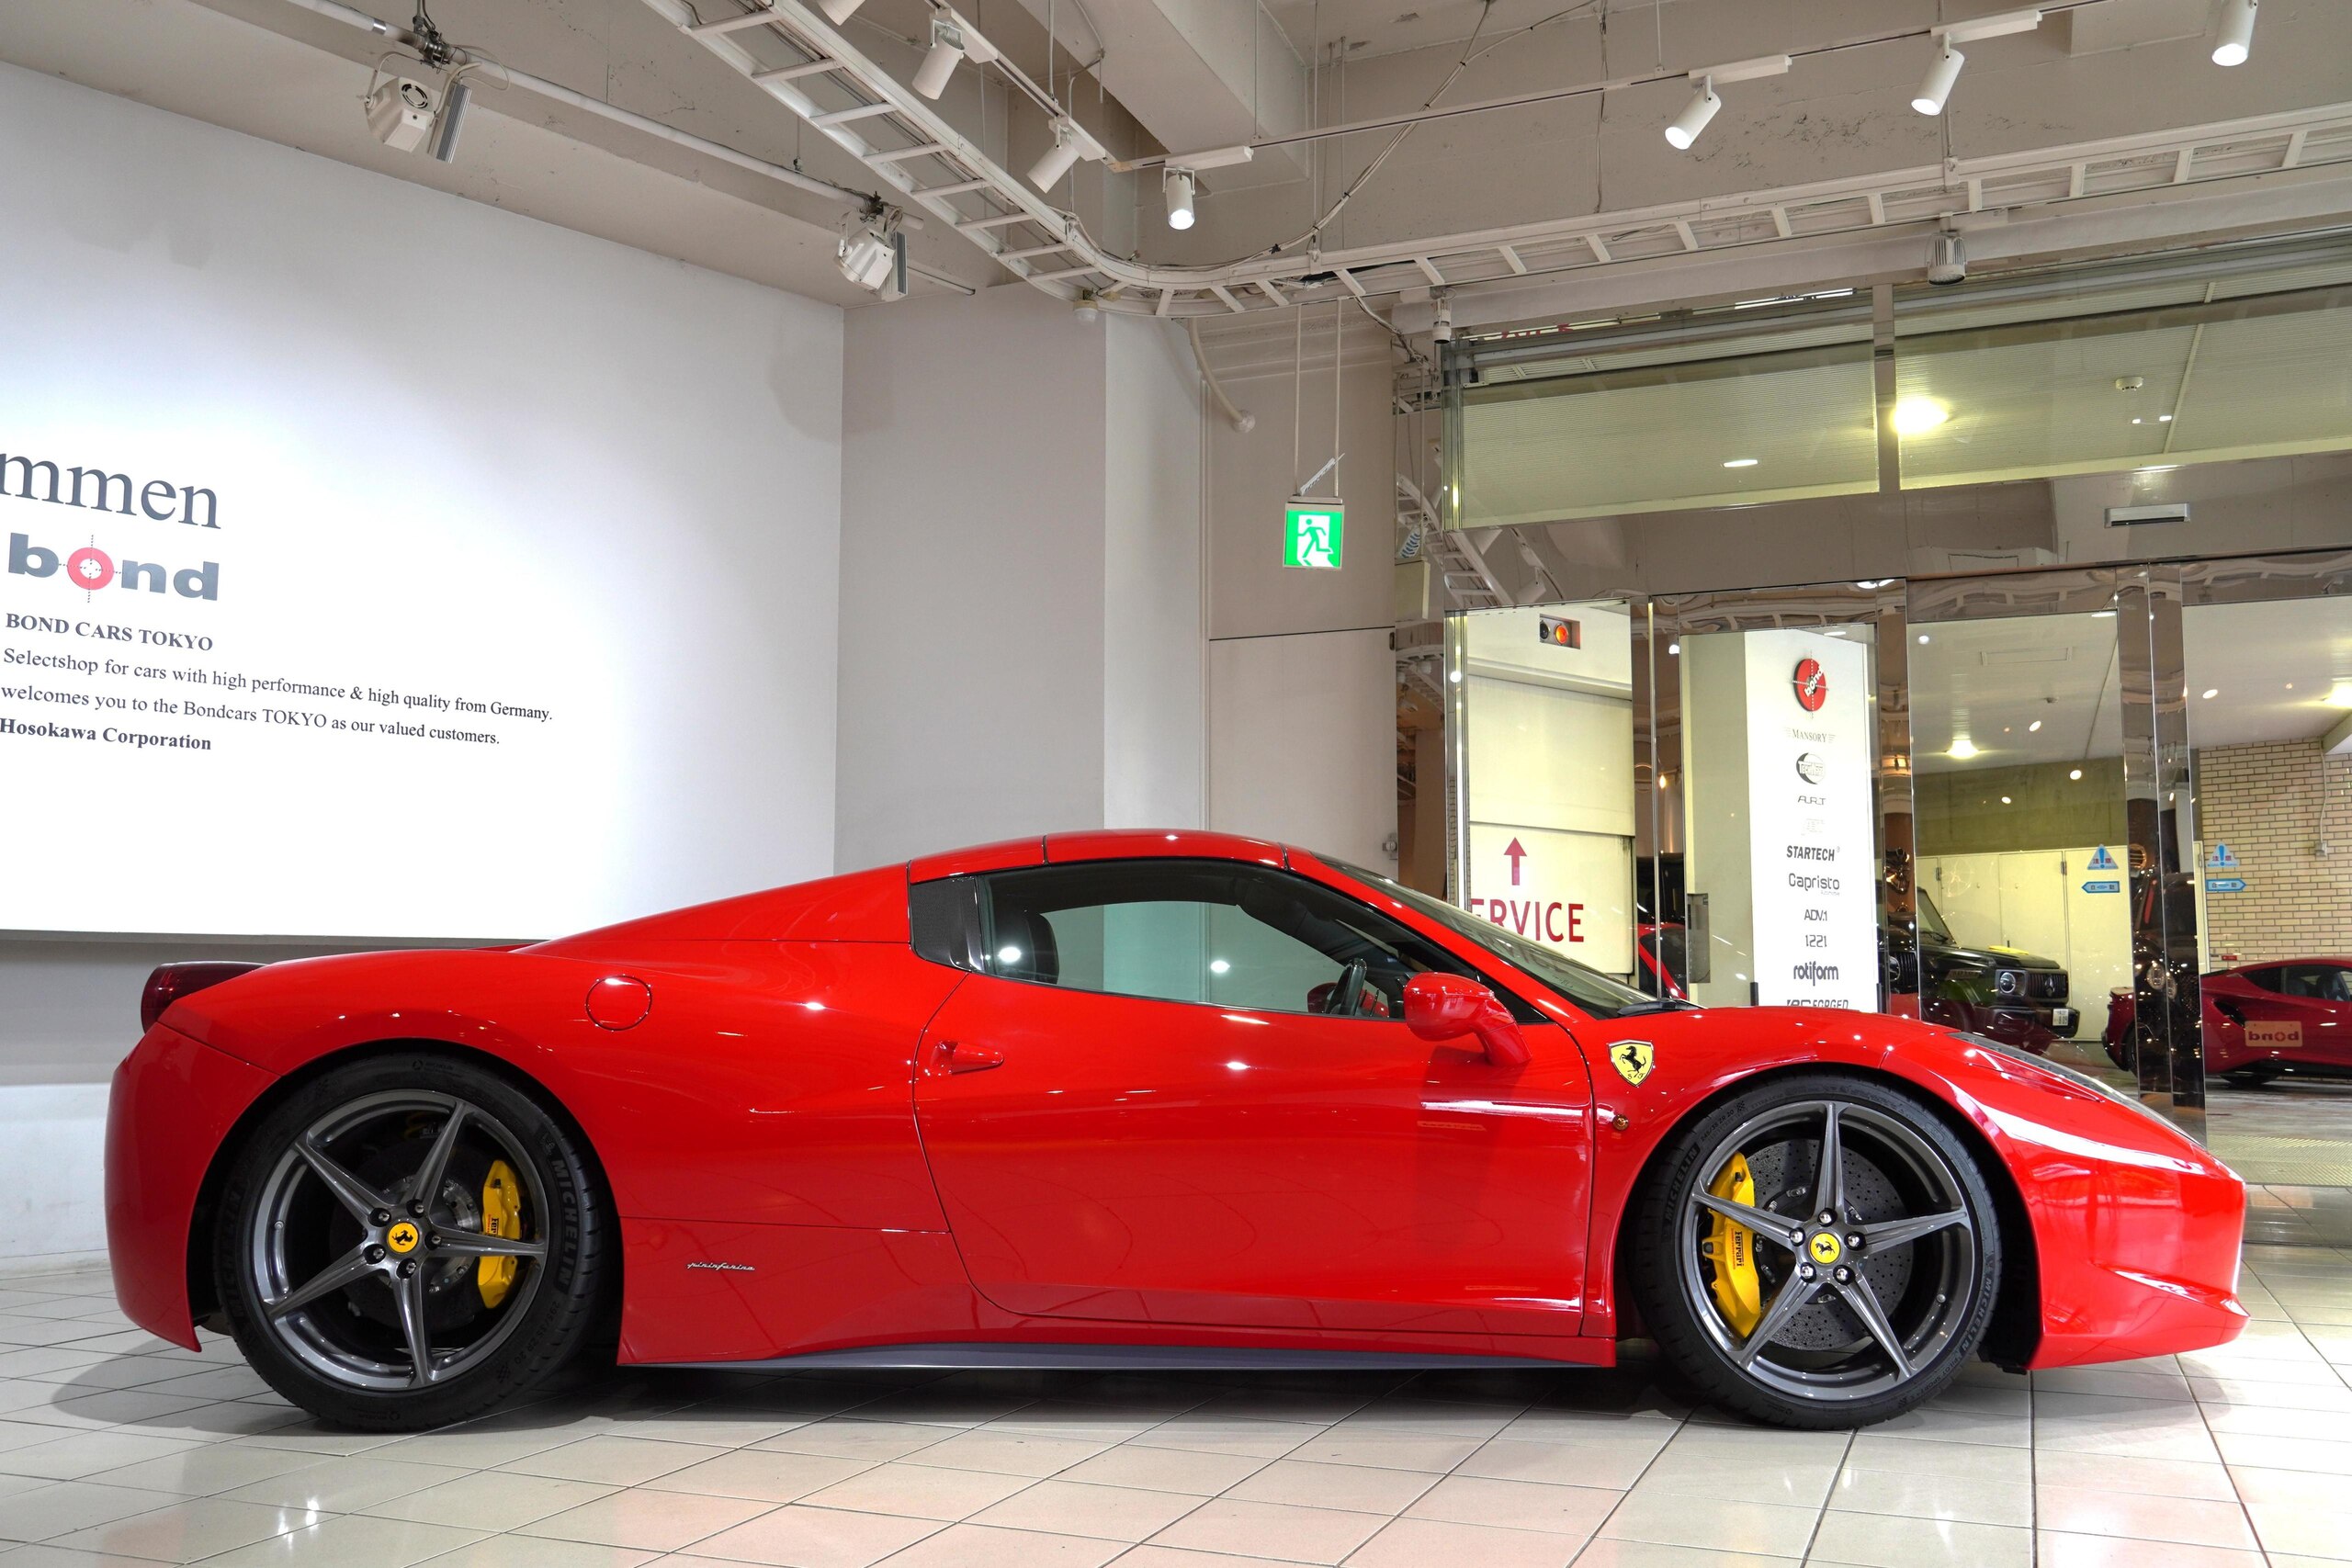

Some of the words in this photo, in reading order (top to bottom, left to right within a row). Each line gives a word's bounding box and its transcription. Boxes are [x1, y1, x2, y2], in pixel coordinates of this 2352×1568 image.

[0, 454, 221, 529] mmen
[8, 532, 220, 602] bond
[6, 614, 69, 633] BOND
[75, 622, 132, 641] CARS
[139, 629, 212, 650] TOKYO
[4, 649, 97, 675] Selectshop
[106, 660, 129, 674] for
[134, 667, 166, 679] cars
[173, 670, 207, 683] with
[213, 671, 246, 690] high
[252, 678, 345, 697] performance
[350, 686, 362, 700] &
[368, 688, 399, 705] high
[404, 694, 450, 712] quality
[456, 697, 486, 713] from
[491, 702, 551, 722] Germany.
[1804, 665, 1824, 697] bond
[1, 686, 89, 705] welcomes
[96, 696, 126, 710] you
[132, 699, 147, 710] to
[153, 699, 177, 714] the
[185, 701, 256, 721] Bondcars
[263, 709, 326, 728] TOKYO
[332, 719, 346, 729] as
[351, 721, 375, 732] our
[379, 722, 424, 737] valued
[429, 729, 499, 744] customers.
[0, 718, 96, 739] Hosokawa
[103, 728, 210, 750] Corporation
[1792, 728, 1827, 743] MANSORY
[1786, 845, 1835, 862] STARTECH
[1788, 873, 1840, 891] Capristo
[1805, 934, 1827, 948] 1221
[1793, 961, 1839, 987] rotiform
[551, 1159, 579, 1287] MICHELIN
[687, 1261, 756, 1271] pininfarina
[1735, 1231, 1744, 1267] Ferrari
[1962, 1278, 1992, 1350] MICHELIN
